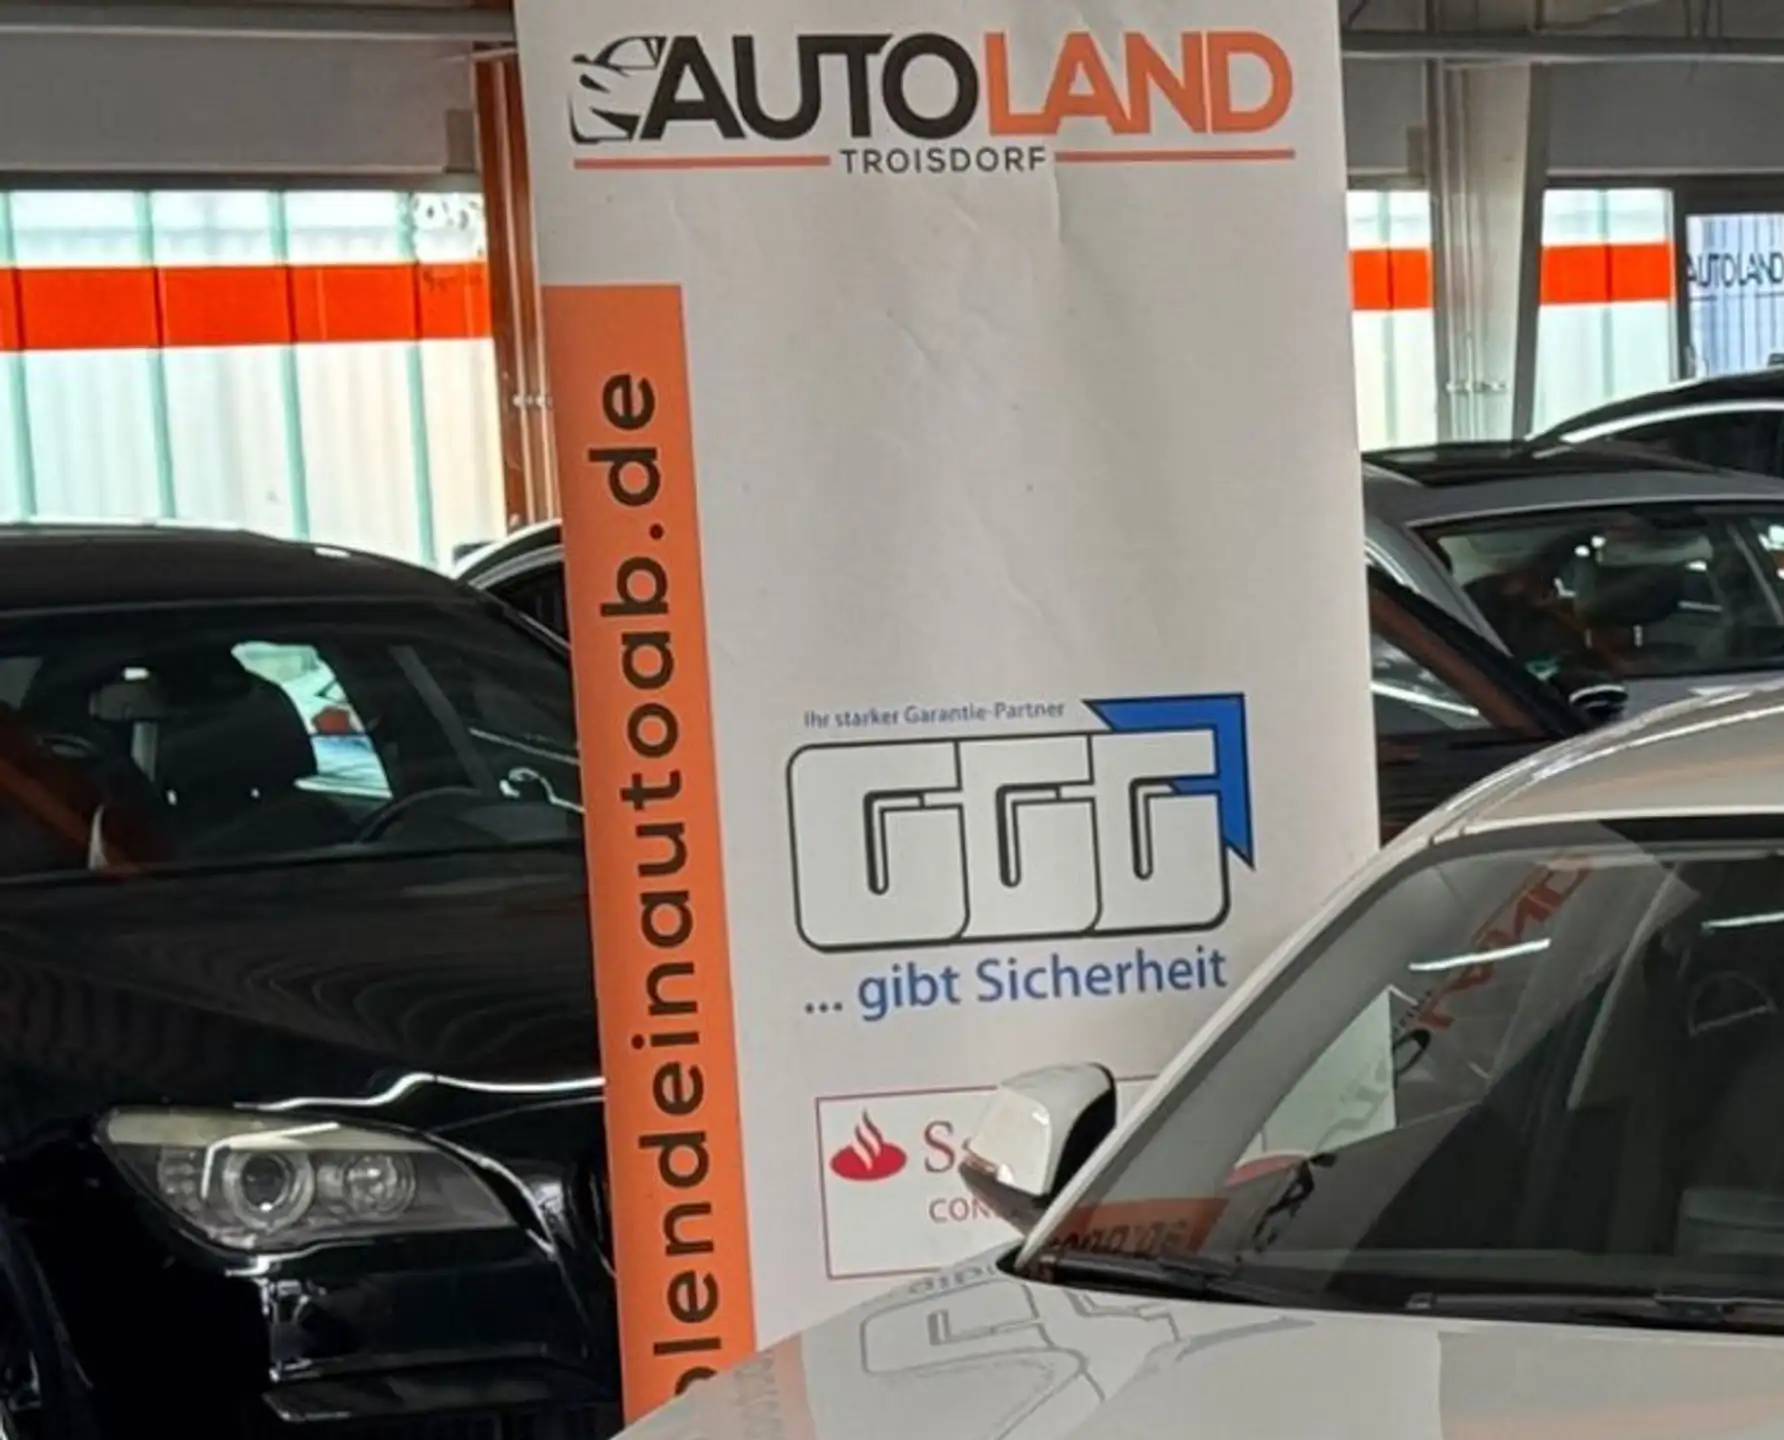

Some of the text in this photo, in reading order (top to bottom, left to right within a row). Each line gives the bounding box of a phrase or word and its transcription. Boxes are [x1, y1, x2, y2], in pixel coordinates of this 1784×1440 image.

[640, 30, 1294, 141] AUTOLAND
[840, 146, 1047, 176] TROISDORF
[803, 700, 1066, 729] Ihr starker Garantie-Partner
[857, 960, 961, 1022] gibt
[975, 944, 1228, 1002] Sicherheit
